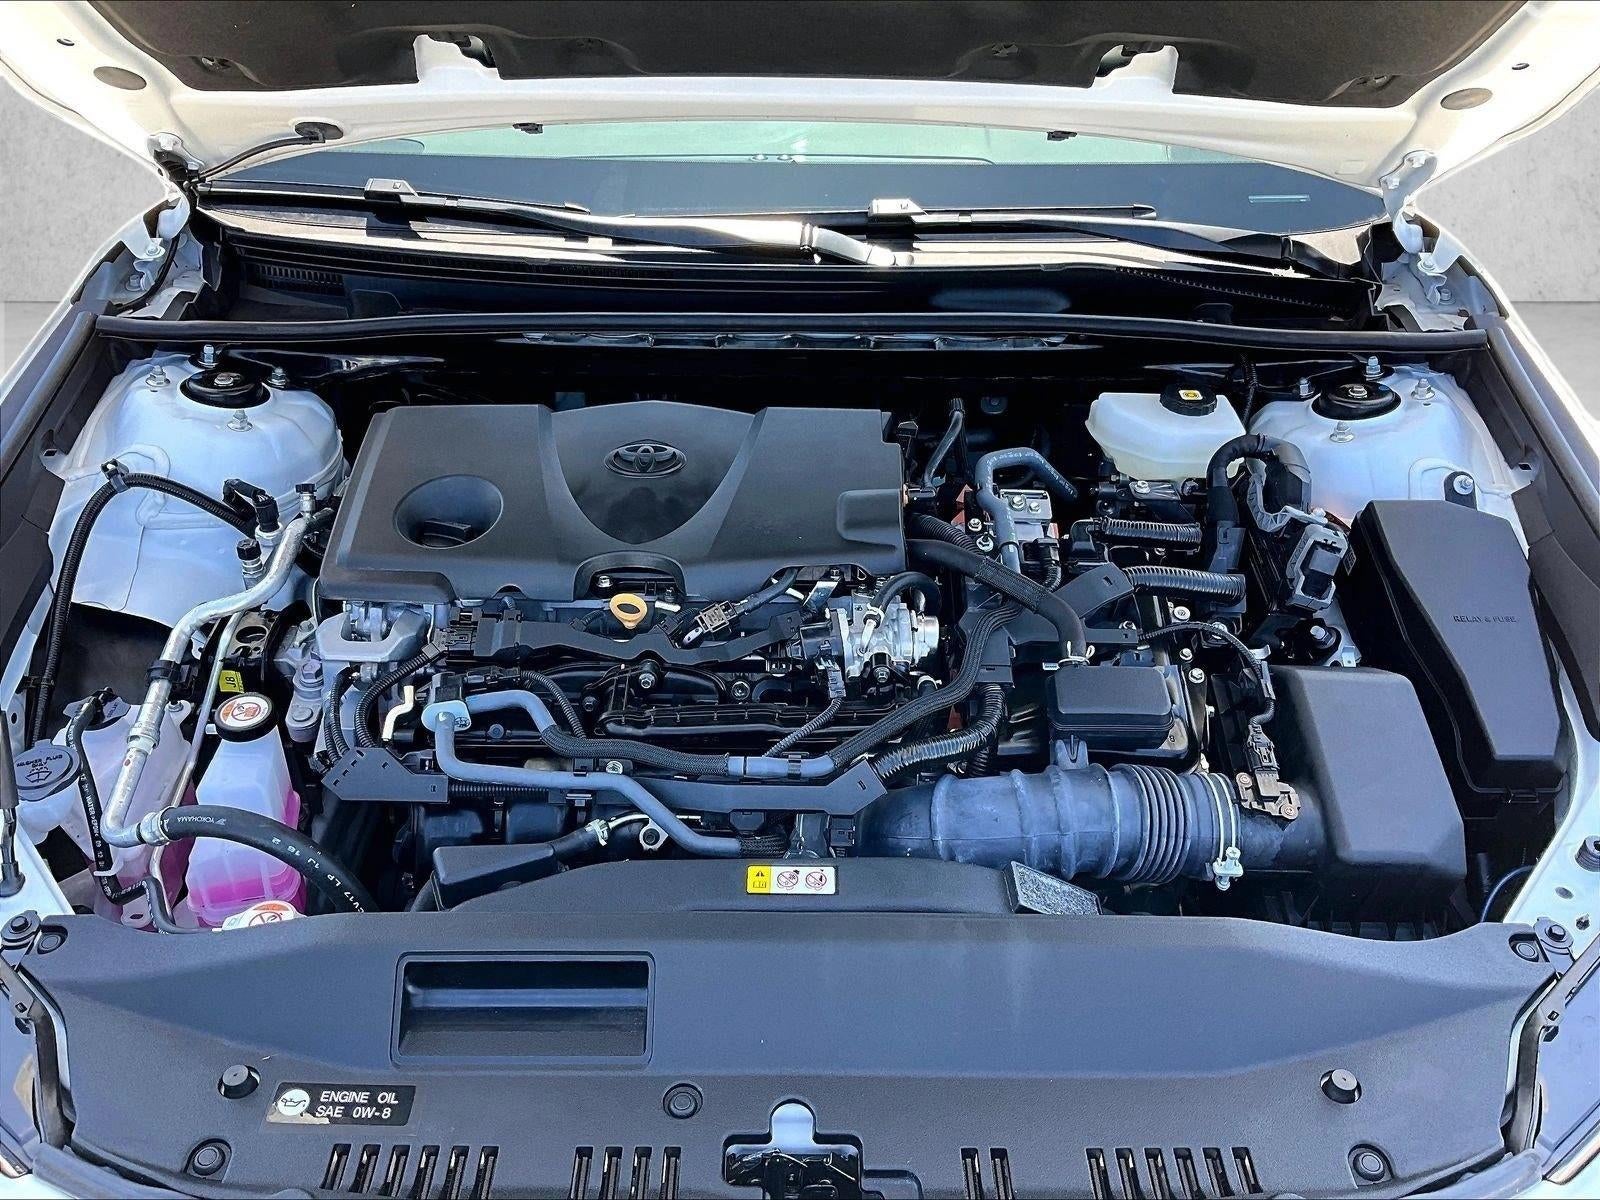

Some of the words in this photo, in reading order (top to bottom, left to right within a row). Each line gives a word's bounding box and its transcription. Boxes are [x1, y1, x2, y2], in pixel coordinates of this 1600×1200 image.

[1452, 615, 1482, 623] RELAY
[1492, 615, 1517, 623] FUSE
[225, 676, 236, 688] J8
[177, 815, 215, 824] YOKOHAMA
[327, 874, 342, 887] LP
[320, 1090, 370, 1103] ENGINE
[377, 1092, 399, 1104] OIL
[315, 1105, 344, 1118] SAE
[352, 1107, 392, 1119] 0W-8
